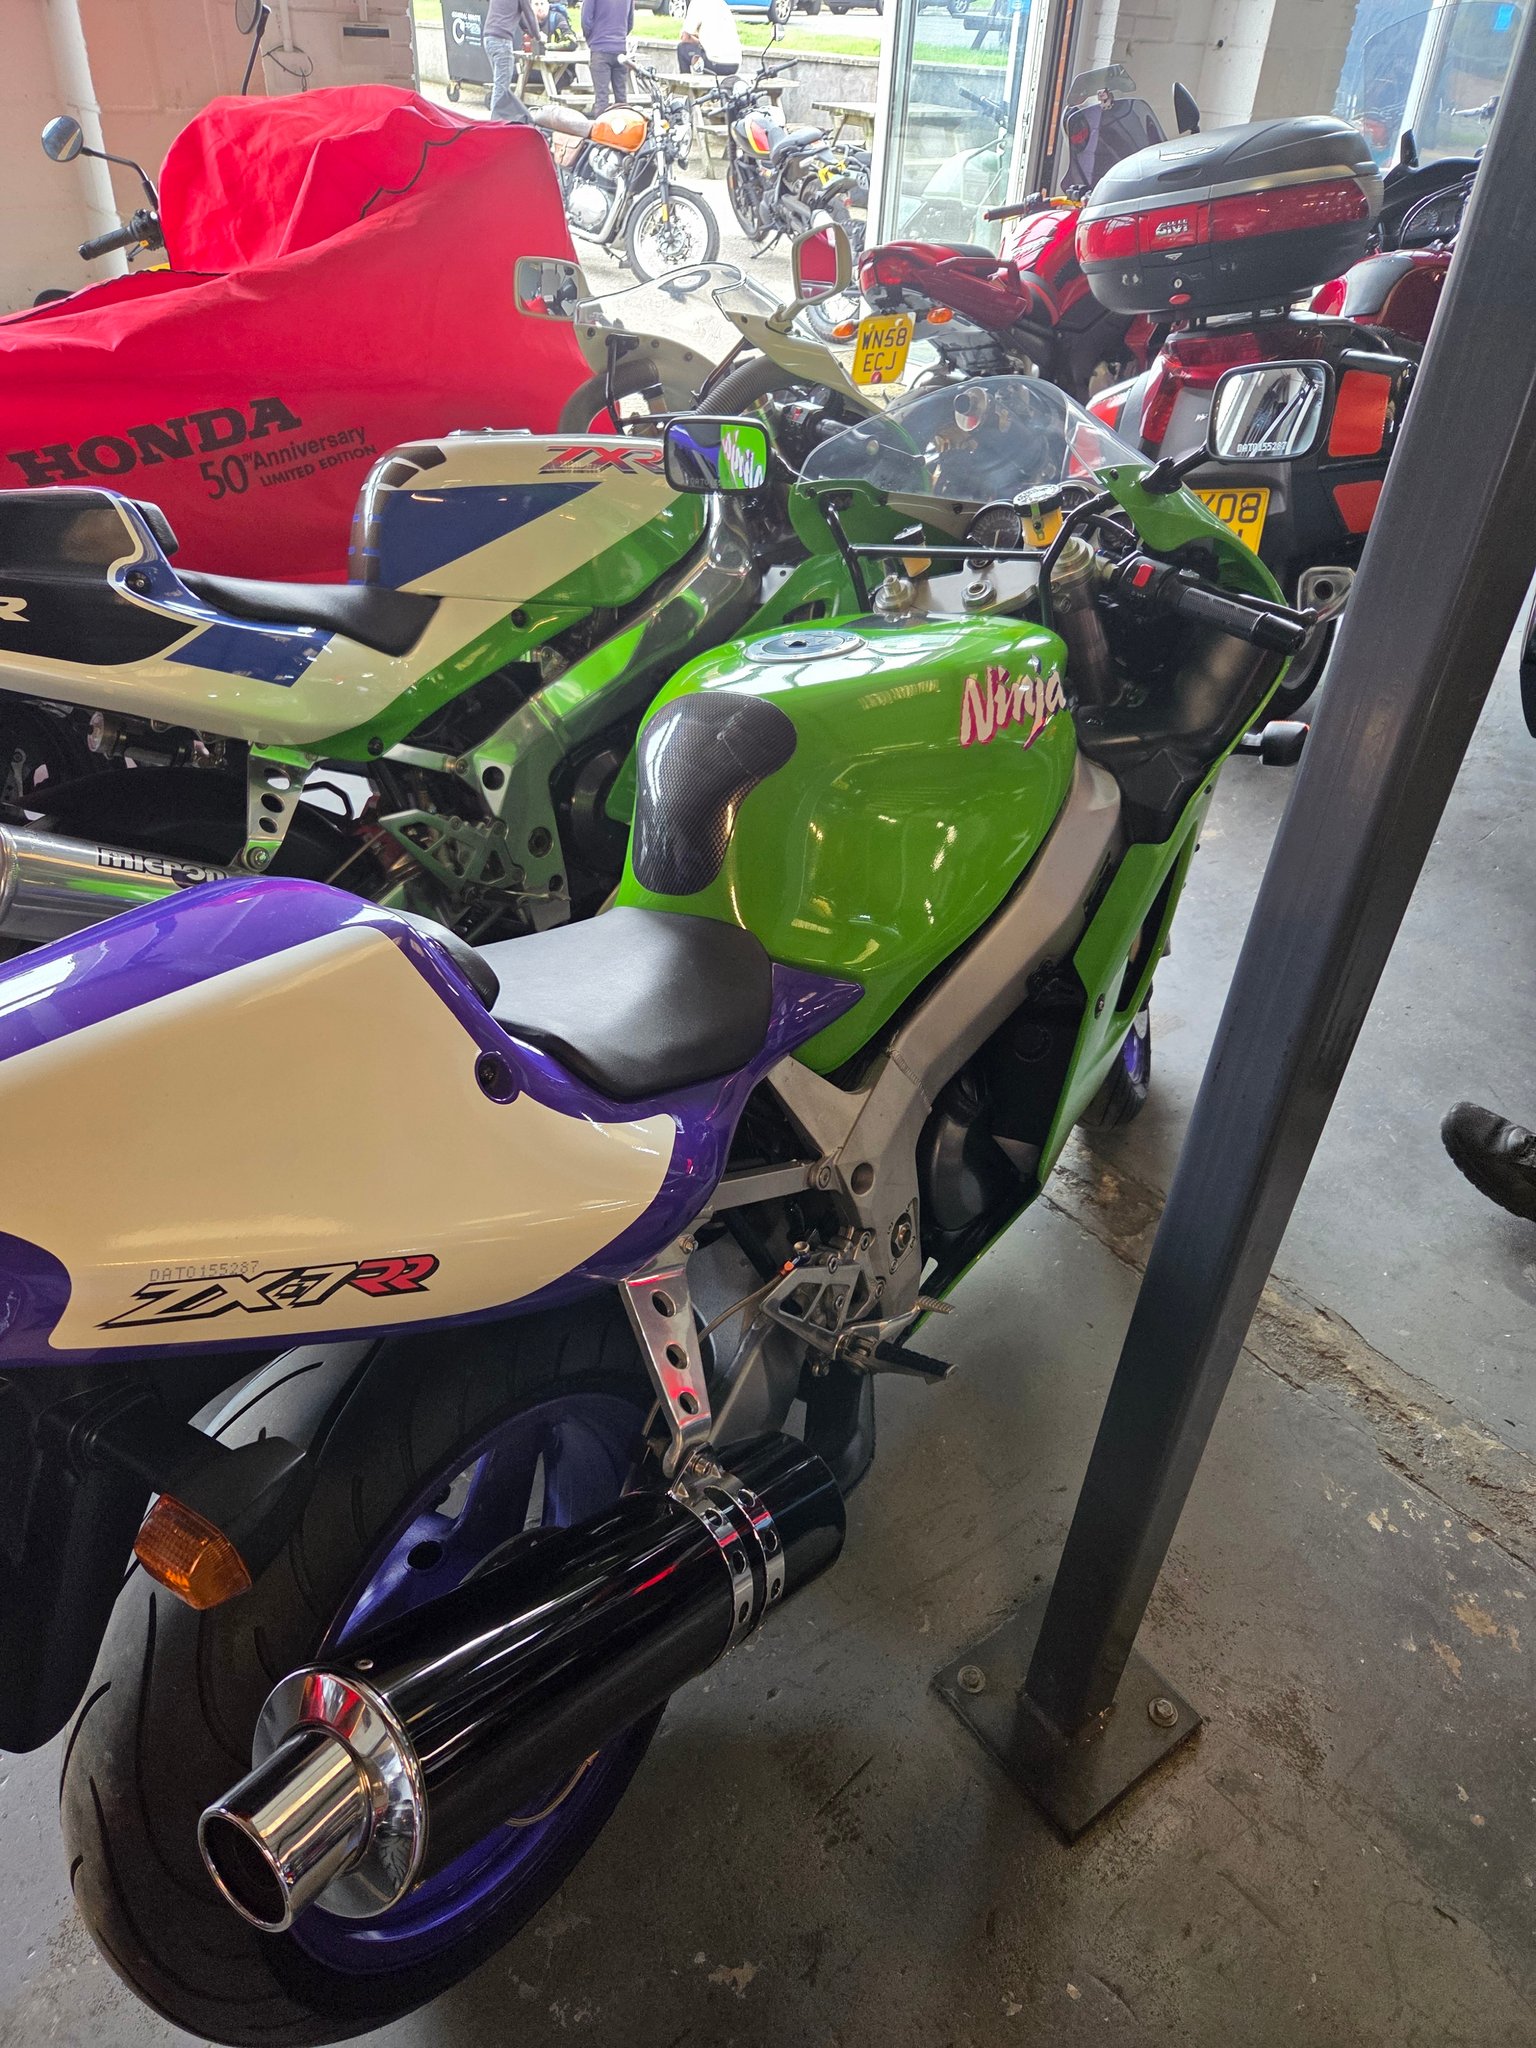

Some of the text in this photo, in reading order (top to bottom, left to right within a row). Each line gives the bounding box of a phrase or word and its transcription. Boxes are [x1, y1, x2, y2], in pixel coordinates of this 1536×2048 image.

[1155, 218, 1189, 237] GIVI
[862, 327, 908, 350] WN58
[863, 351, 897, 372] ECJ
[6, 396, 303, 487] HONDA
[253, 426, 366, 470] Anniversary
[538, 445, 666, 474] ZXR
[260, 444, 378, 487] LIMITED EDITION
[960, 654, 1067, 751] Ninja
